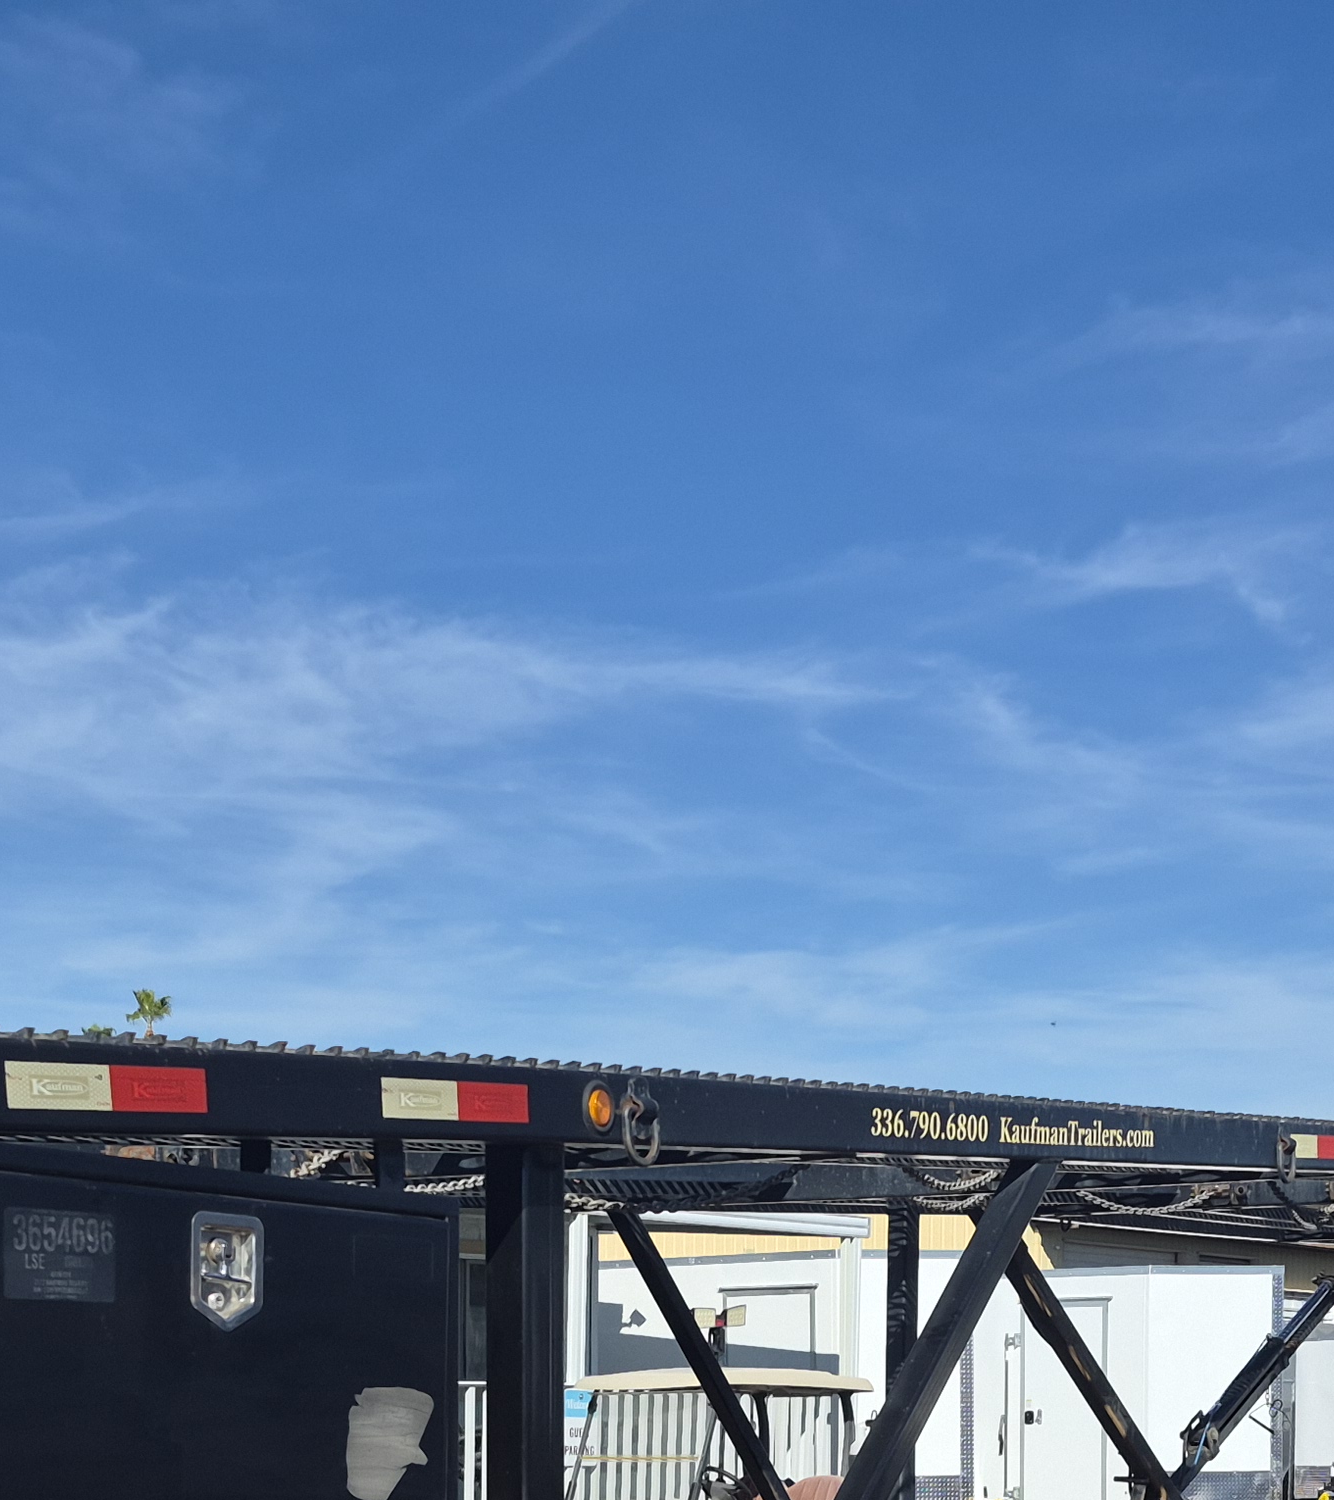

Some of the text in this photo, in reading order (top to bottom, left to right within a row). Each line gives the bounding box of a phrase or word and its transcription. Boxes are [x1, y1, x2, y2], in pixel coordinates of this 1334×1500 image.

[32, 1078, 85, 1096] Kaufman
[871, 1107, 1155, 1148] 336.790.6800 KaufmanTrailers.com
[13, 1213, 115, 1254] 3654696
[24, 1253, 46, 1269] LSE
[564, 1445, 595, 1456] PARNG
